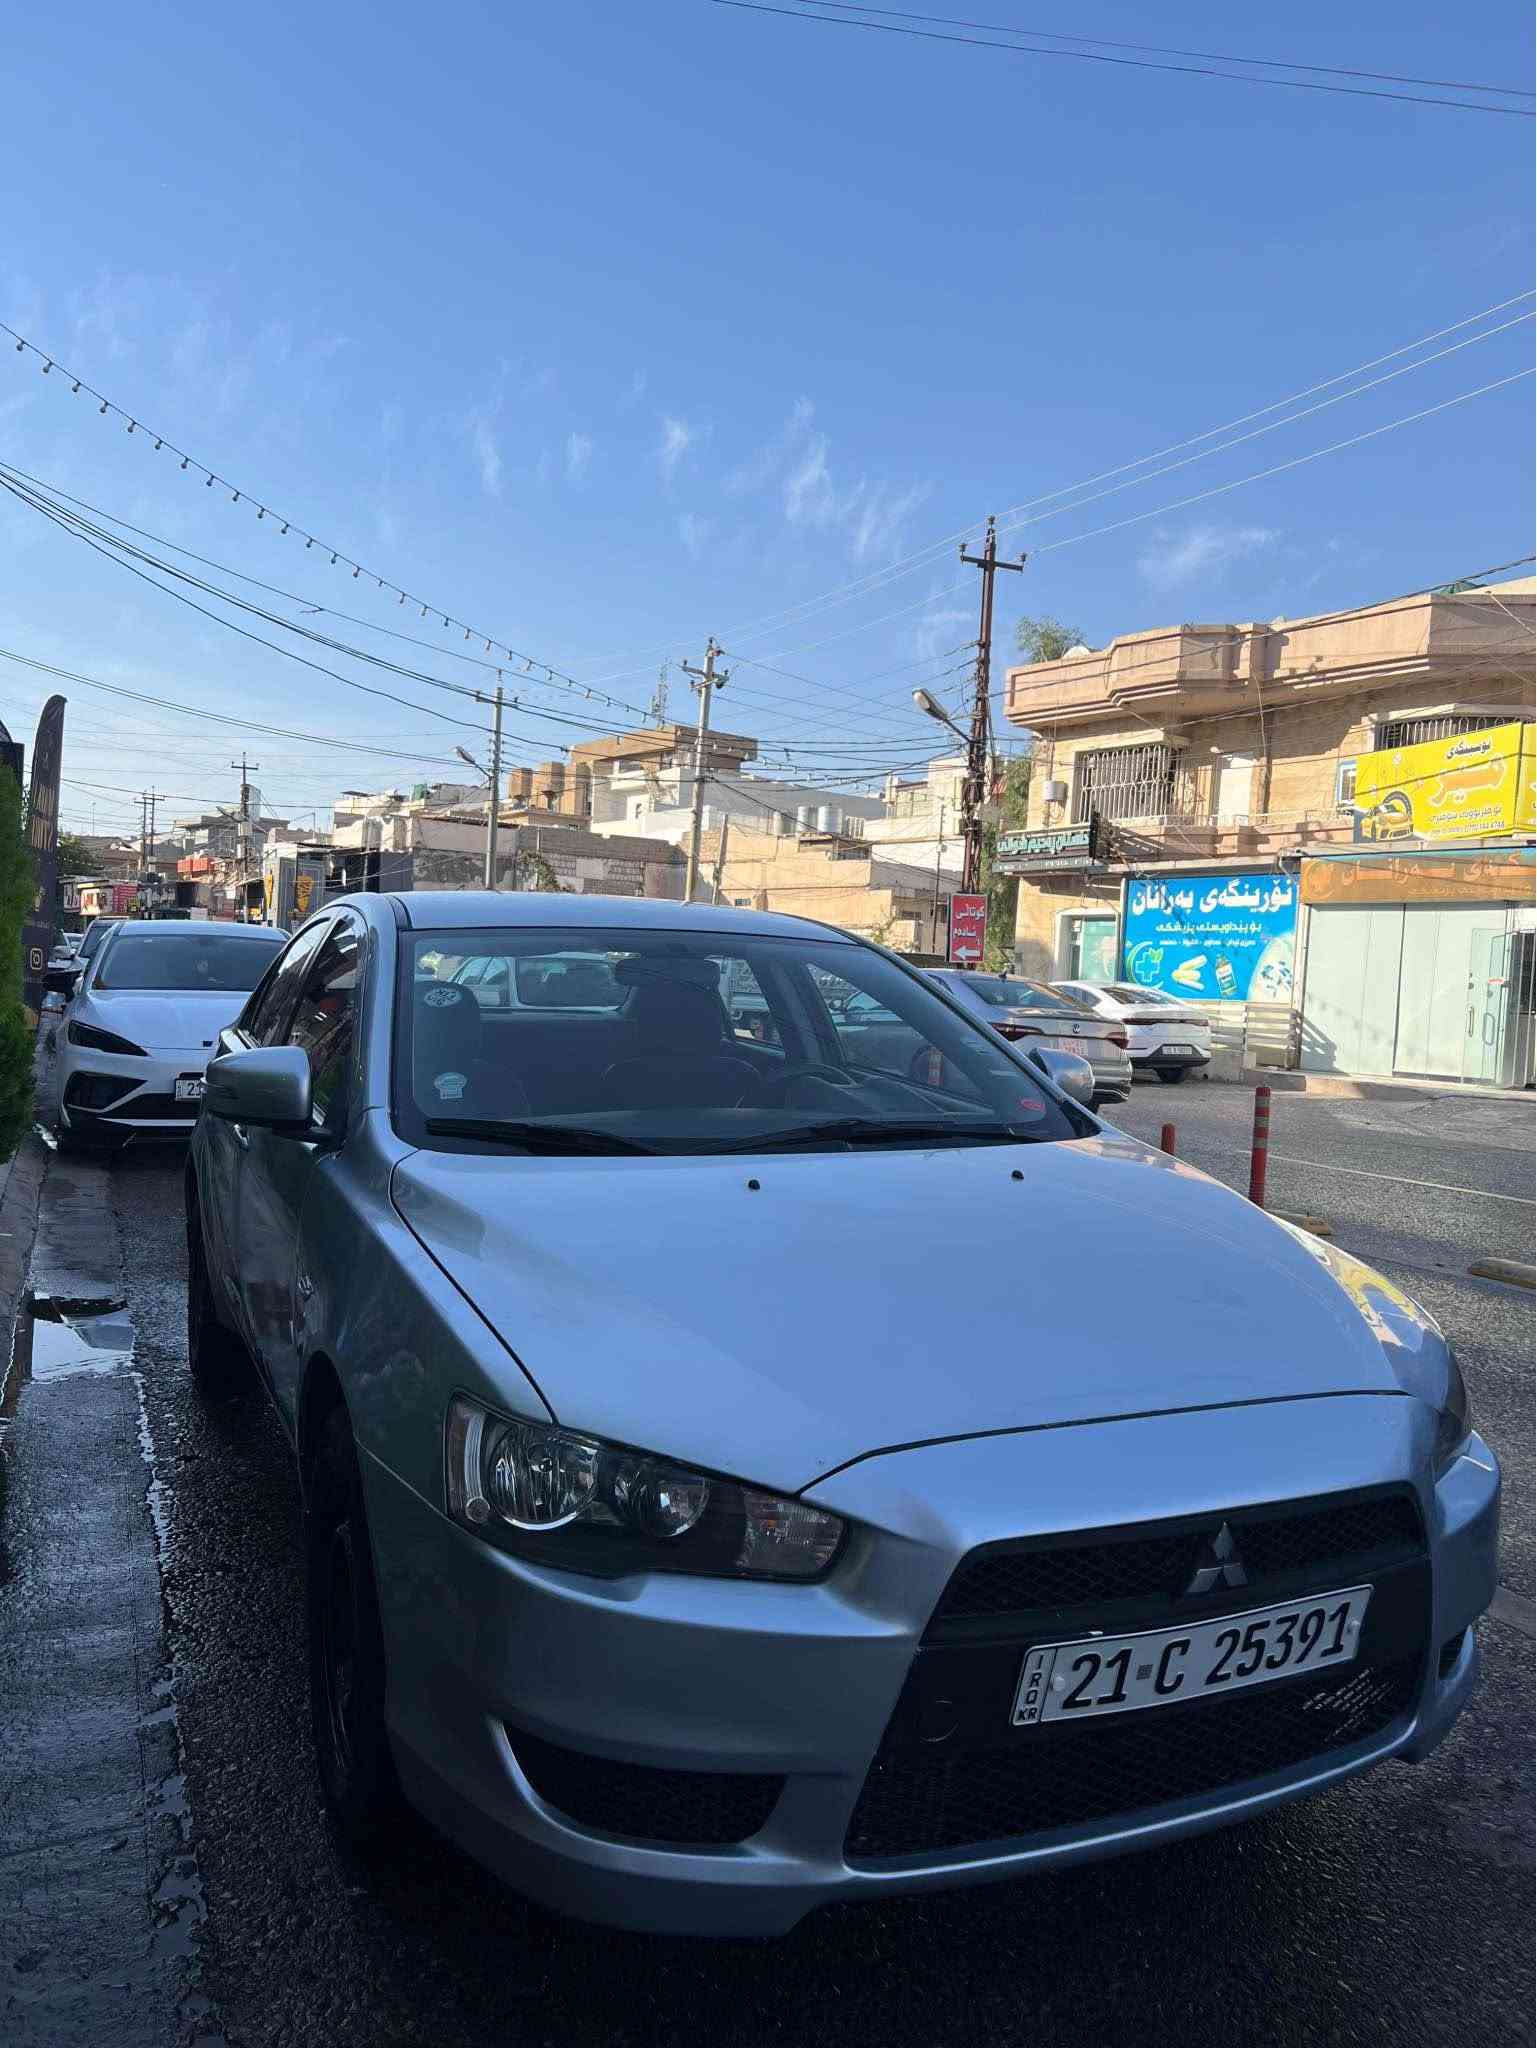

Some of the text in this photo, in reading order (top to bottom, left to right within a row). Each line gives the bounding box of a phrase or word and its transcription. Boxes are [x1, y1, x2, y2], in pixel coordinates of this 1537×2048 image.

[1132, 884, 1194, 915] بەرانان
[1062, 1601, 1352, 1710] 21 C 25391
